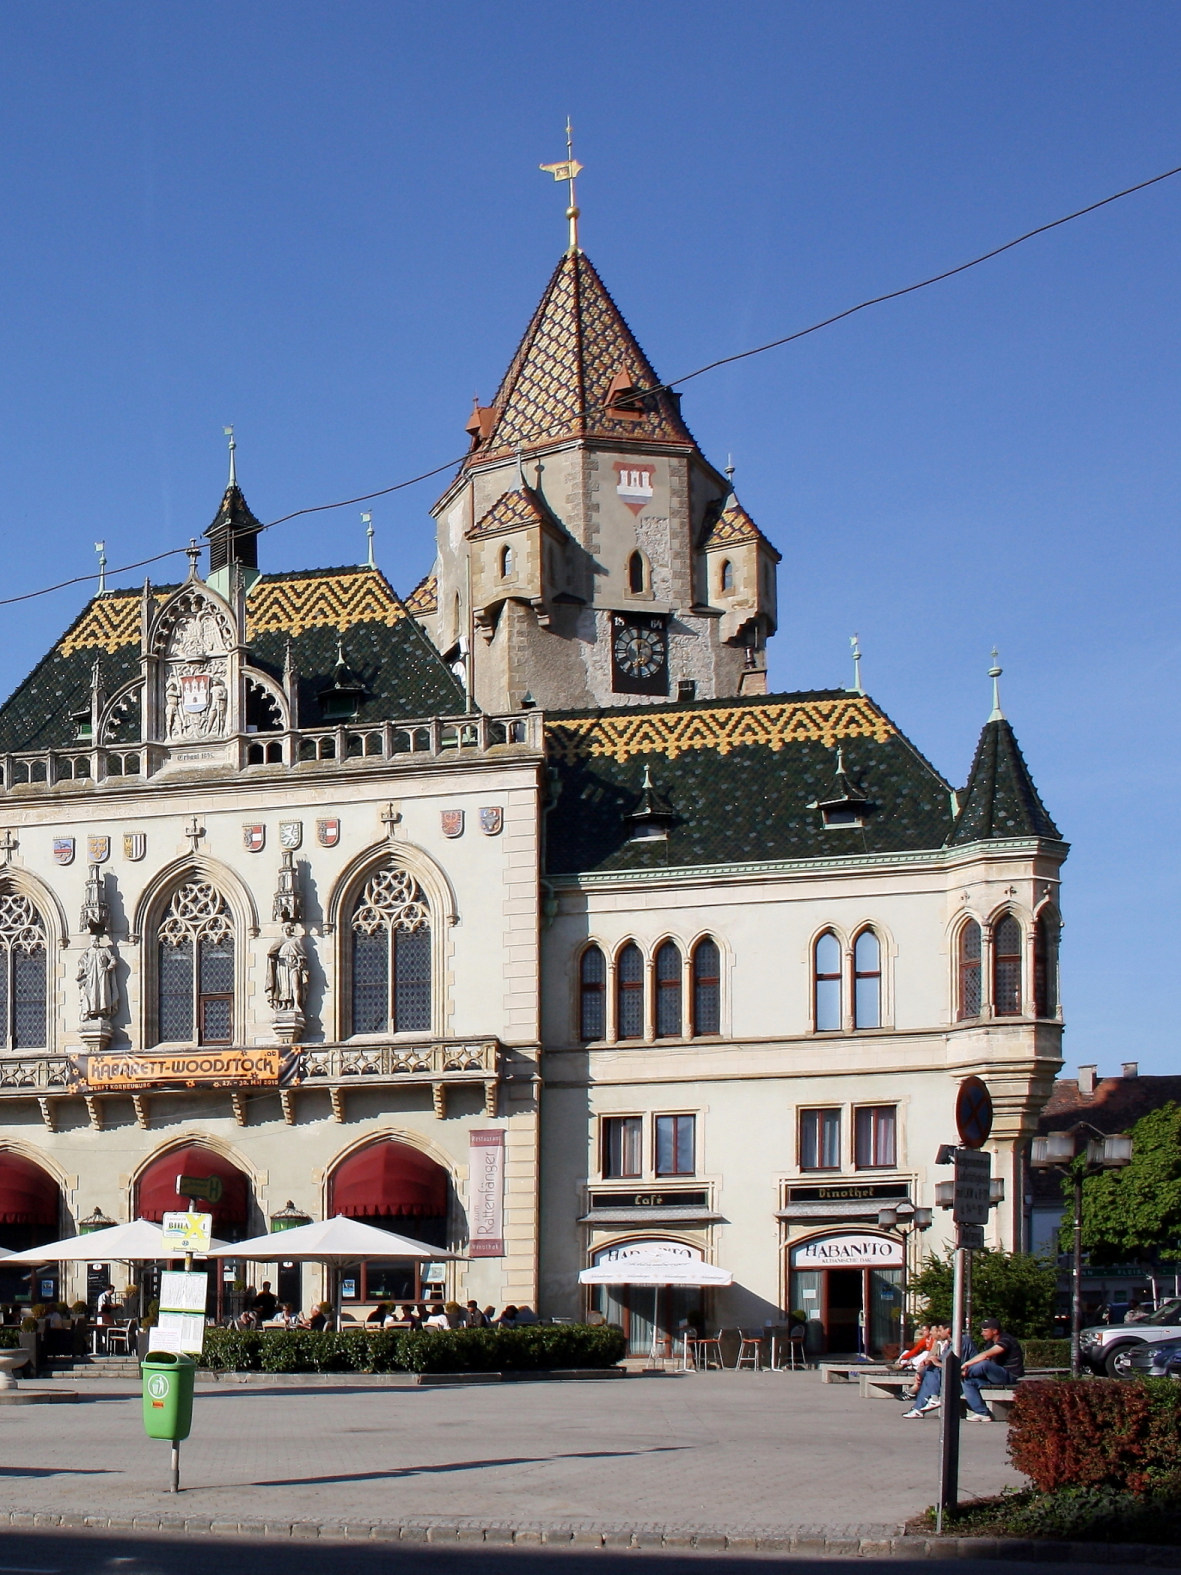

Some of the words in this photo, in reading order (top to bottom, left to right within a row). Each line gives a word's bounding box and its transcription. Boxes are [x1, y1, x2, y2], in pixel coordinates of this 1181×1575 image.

[91, 1058, 275, 1080] KABARETT-WOODSTOCK
[110, 1082, 152, 1091] KORNEUBURG
[477, 1152, 498, 1235] Rattenfänger
[634, 1194, 664, 1206] Café
[805, 1242, 893, 1259] HABANITO
